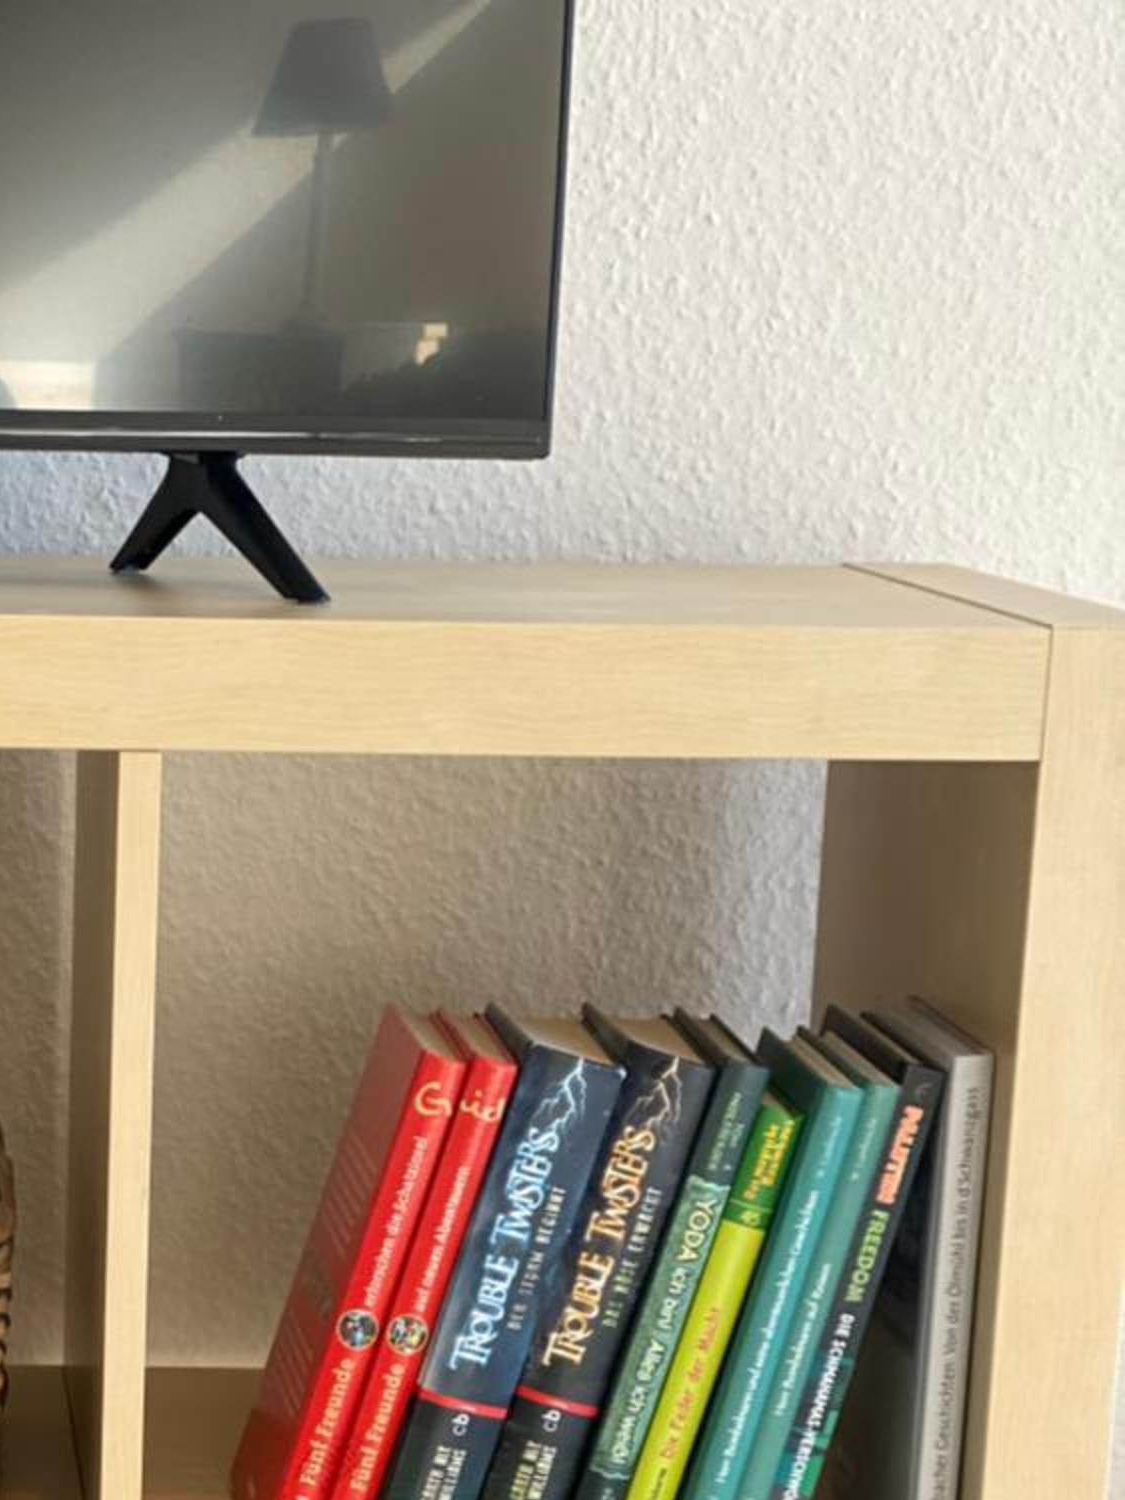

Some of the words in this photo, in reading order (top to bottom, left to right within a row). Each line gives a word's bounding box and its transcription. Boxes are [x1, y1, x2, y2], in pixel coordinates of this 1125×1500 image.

[449, 1254, 517, 1368] TROUBLE
[491, 1127, 558, 1243] TWISTERS
[543, 1252, 613, 1364] TROUBLE
[585, 1126, 654, 1246] TWISTERS
[677, 1195, 716, 1260] YODA
[846, 1210, 888, 1301] FREEDOM
[669, 1266, 687, 1294] ich
[350, 1446, 378, 1492] Fünf
[365, 1363, 405, 1443] Freunde
[414, 1287, 430, 1313] auf
[422, 1245, 444, 1287] neuen
[435, 1165, 470, 1244] Abenteuern
[835, 1313, 854, 1337] DIE
[946, 1300, 960, 1323] der
[637, 1338, 668, 1384] Alles
[943, 1327, 958, 1356] Von
[687, 1358, 703, 1382] der
[299, 1439, 328, 1487] Fünf
[315, 1358, 356, 1438] Freunde
[628, 1385, 650, 1414] ich
